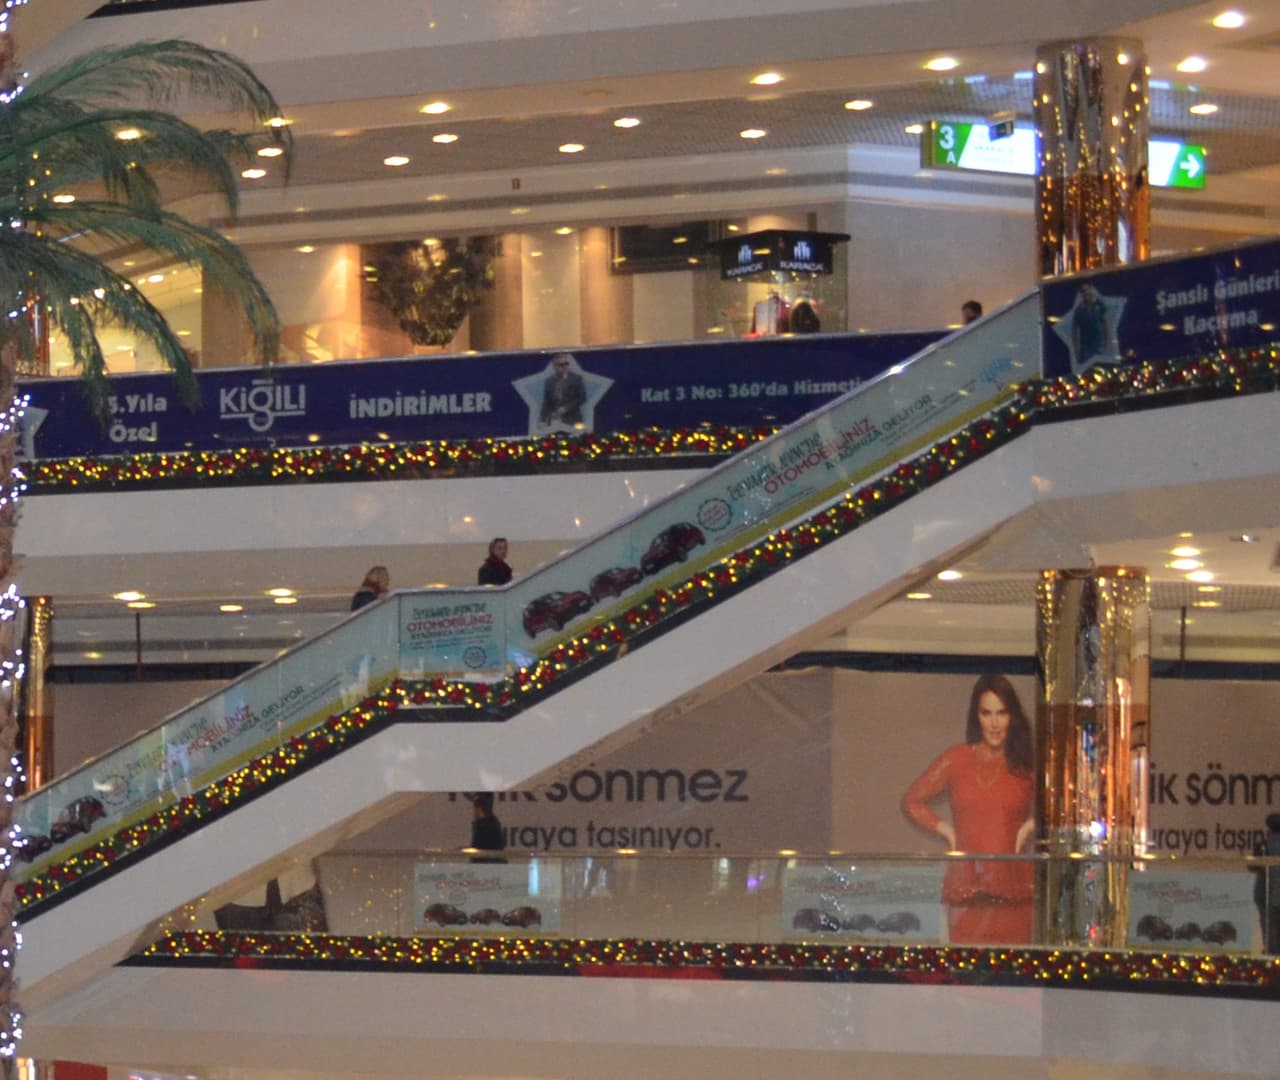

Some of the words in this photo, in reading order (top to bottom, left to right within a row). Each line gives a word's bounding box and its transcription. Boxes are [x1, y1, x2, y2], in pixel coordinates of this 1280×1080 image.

[940, 126, 954, 150] 3
[947, 151, 957, 164] A
[1156, 282, 1208, 316] Şanslı
[1214, 268, 1280, 299] Günleri
[104, 392, 167, 415] 5.Yıla
[641, 387, 670, 403] Kat
[676, 386, 686, 401] 3
[692, 385, 723, 400] No:
[729, 382, 789, 398] 360'da
[350, 390, 492, 420] İNDİRİMLER
[109, 421, 158, 443] Özel
